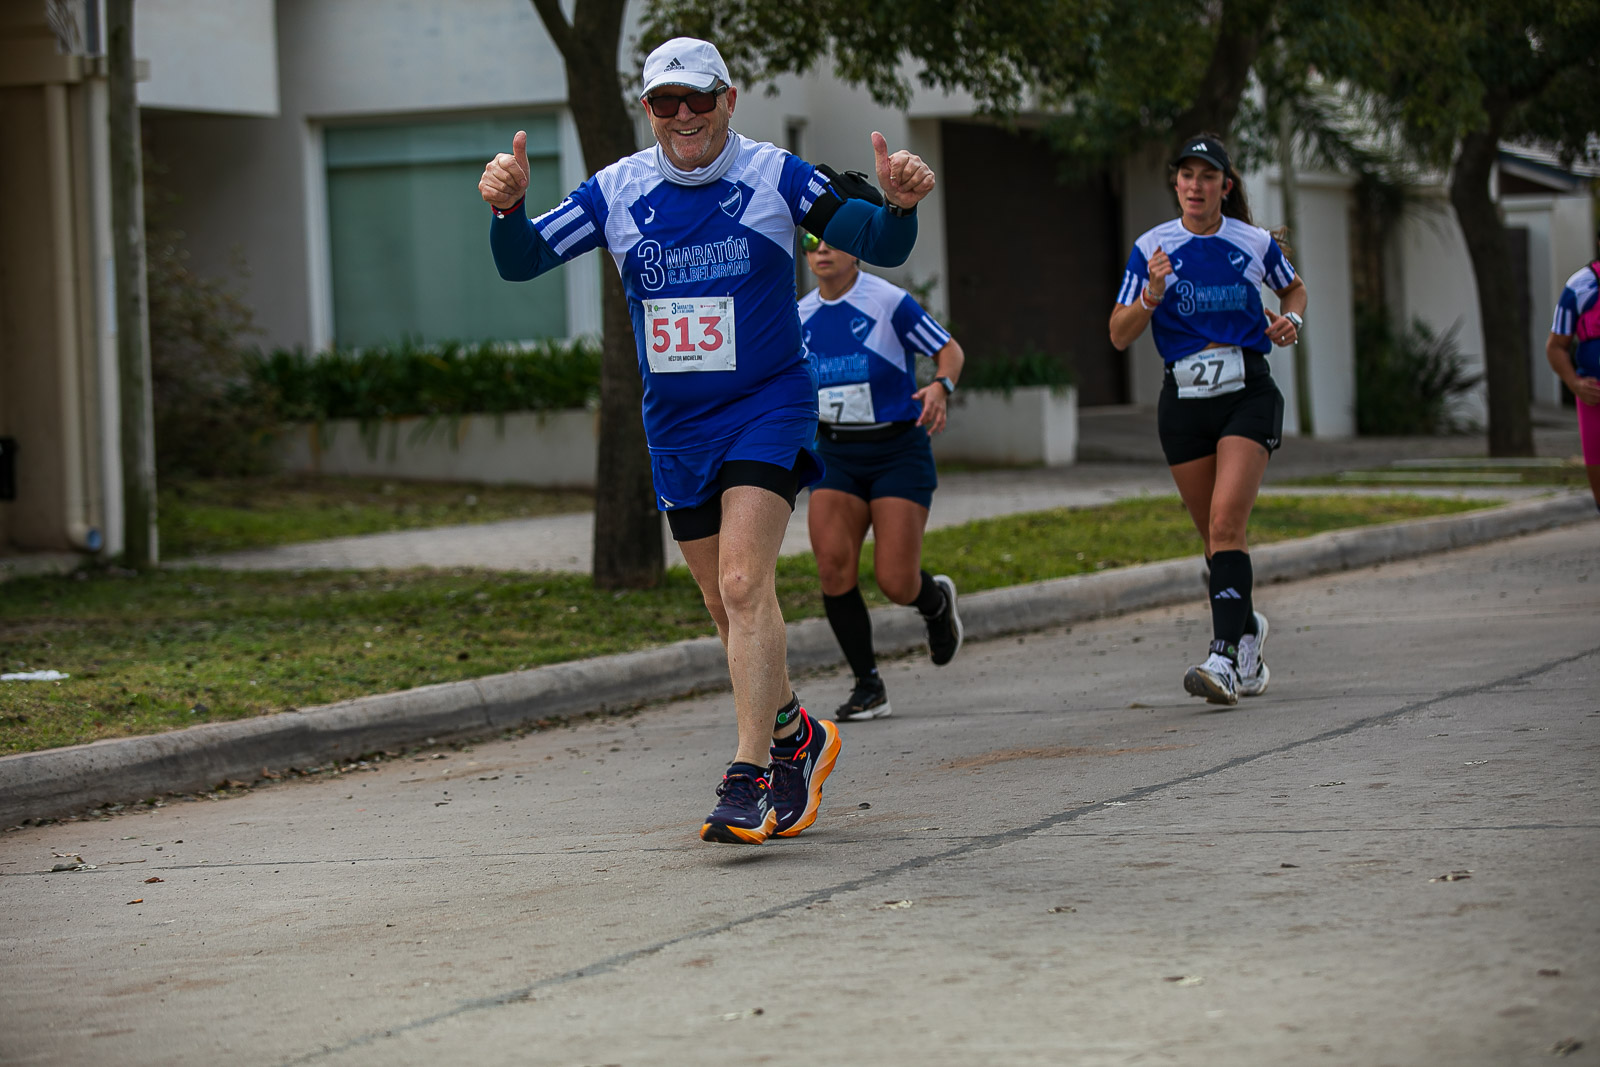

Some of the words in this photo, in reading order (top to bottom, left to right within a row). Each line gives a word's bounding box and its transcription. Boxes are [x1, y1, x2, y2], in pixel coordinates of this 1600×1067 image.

[663, 65, 685, 73] adidas
[637, 239, 666, 292] 3
[665, 236, 750, 270] MARATÓN
[1176, 279, 1196, 316] 3
[652, 316, 724, 353] 513
[1190, 360, 1224, 386] 27
[830, 401, 844, 424] 7
